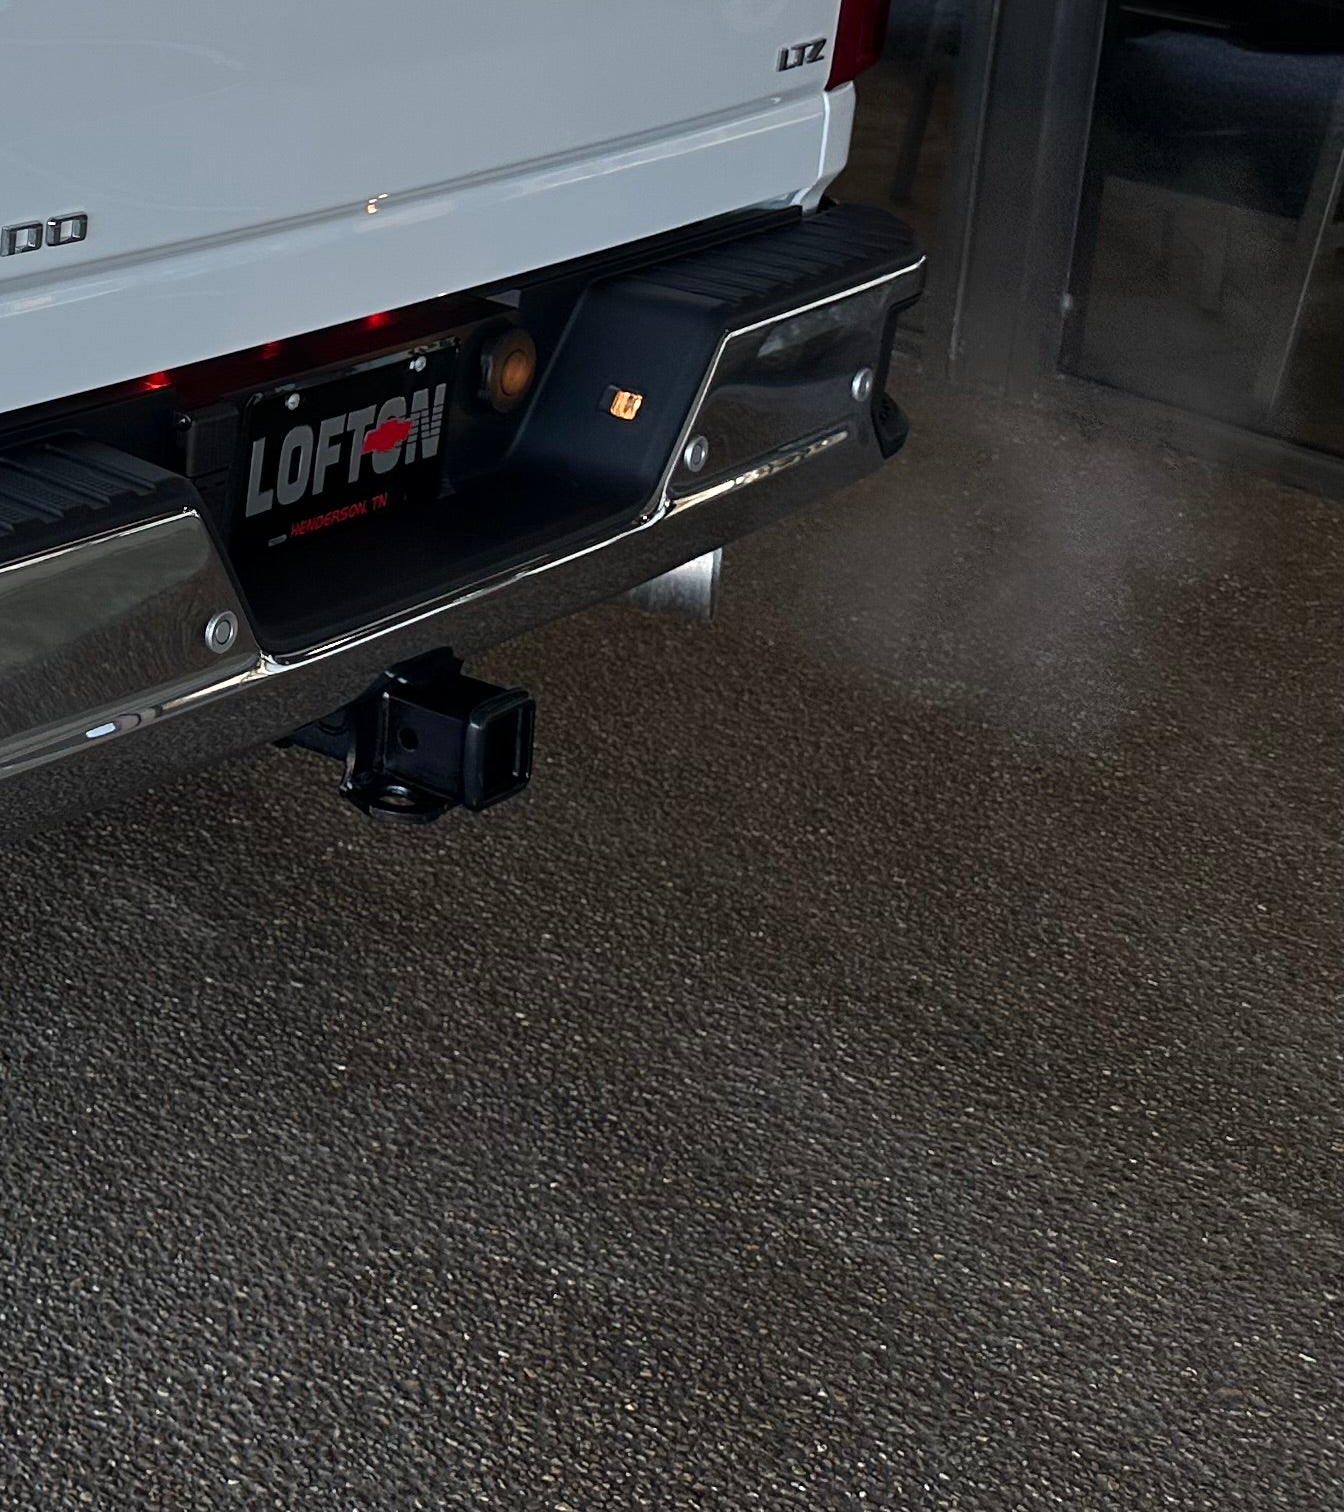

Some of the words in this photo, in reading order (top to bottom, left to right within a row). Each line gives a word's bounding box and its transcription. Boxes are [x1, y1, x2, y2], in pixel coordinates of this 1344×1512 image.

[775, 36, 827, 73] LTZ
[245, 383, 447, 519] LOFTON
[372, 493, 389, 512] TN
